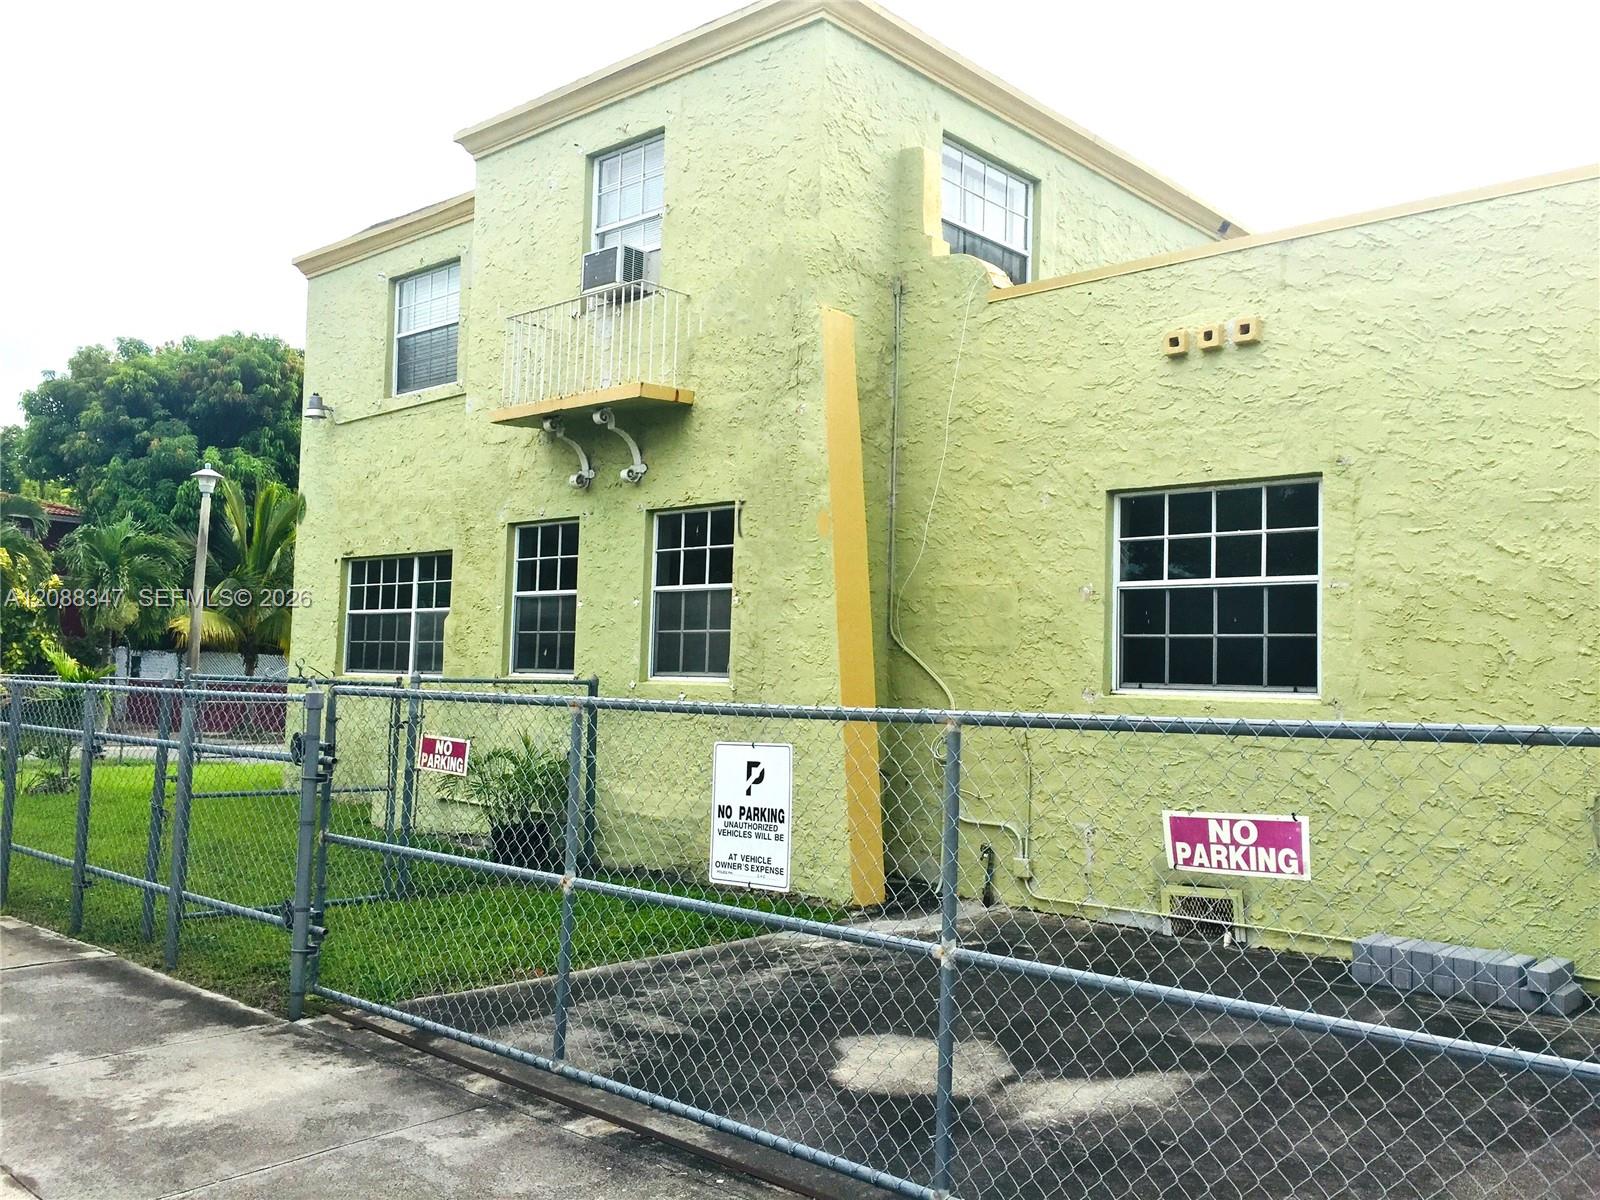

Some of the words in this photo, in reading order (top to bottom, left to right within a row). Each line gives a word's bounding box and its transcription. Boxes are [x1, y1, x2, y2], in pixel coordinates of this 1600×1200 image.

[435, 740, 453, 756] NO
[421, 752, 464, 773] PARKING
[717, 804, 732, 819] NO
[739, 806, 785, 824] PARKING
[724, 821, 779, 832] UNAUTHORIZED
[1208, 819, 1258, 845] NO
[717, 829, 752, 839] VEHICLES
[754, 832, 772, 841] WILL
[774, 834, 784, 842] BE
[728, 853, 738, 861] AT
[740, 855, 772, 865] VEHICLE
[1175, 841, 1299, 874] PARKING
[715, 861, 749, 872] OWNER'S
[750, 864, 784, 876] EXPENSE
